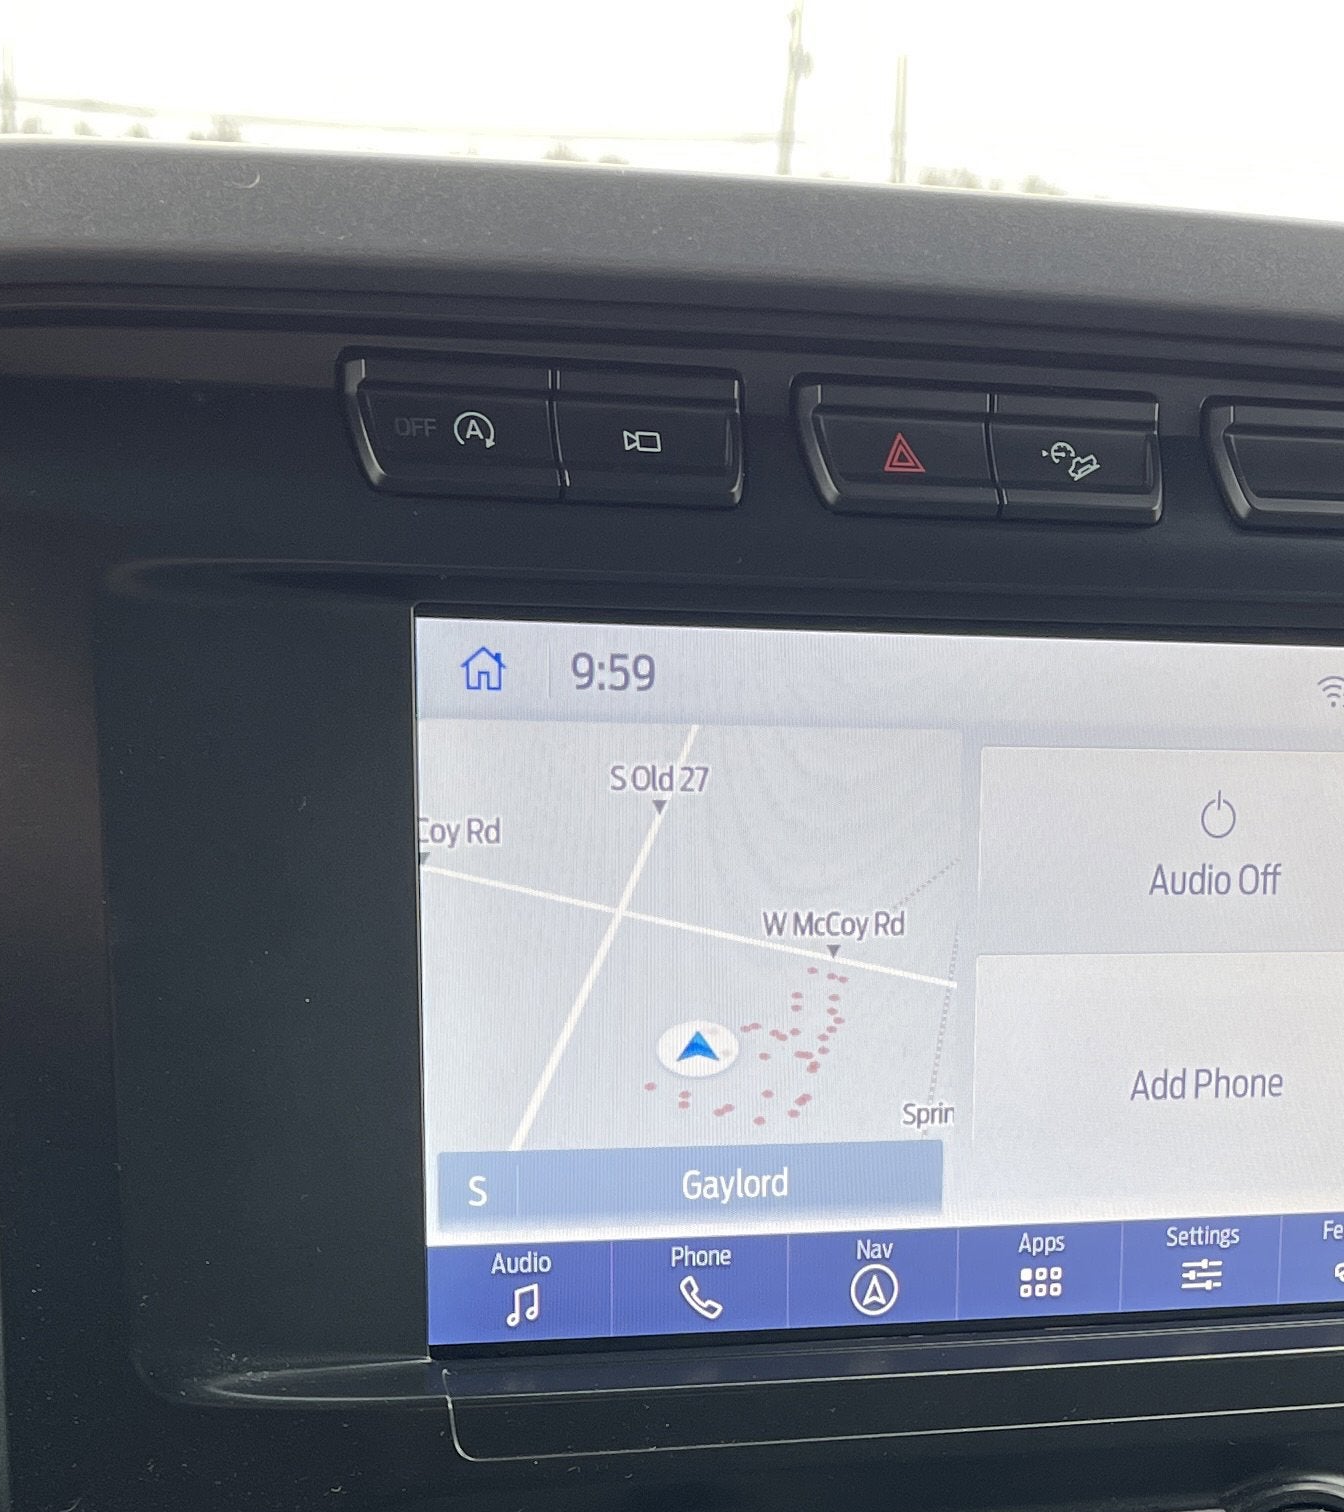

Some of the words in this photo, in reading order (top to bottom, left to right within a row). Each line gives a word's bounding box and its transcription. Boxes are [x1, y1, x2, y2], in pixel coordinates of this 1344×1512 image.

[394, 417, 437, 438] OFF
[570, 651, 657, 693] 9:59
[609, 765, 628, 793] S
[630, 764, 674, 793] Old
[679, 765, 710, 793] 27
[466, 817, 502, 846] Rd
[1148, 863, 1231, 897] Audio
[1238, 862, 1283, 897] Off
[762, 912, 789, 937] W
[792, 911, 869, 942] McCoy
[874, 911, 905, 937] Rd
[1130, 1067, 1187, 1101] Add
[1193, 1066, 1284, 1099] Phone
[902, 1102, 955, 1131] Sprin
[467, 1175, 489, 1208] S
[681, 1166, 789, 1205] Gaylord
[855, 1240, 894, 1261] Nav
[1018, 1231, 1066, 1256] Apps
[1165, 1224, 1241, 1250] Settings
[490, 1252, 552, 1275] Audio
[670, 1245, 732, 1268] Phone
